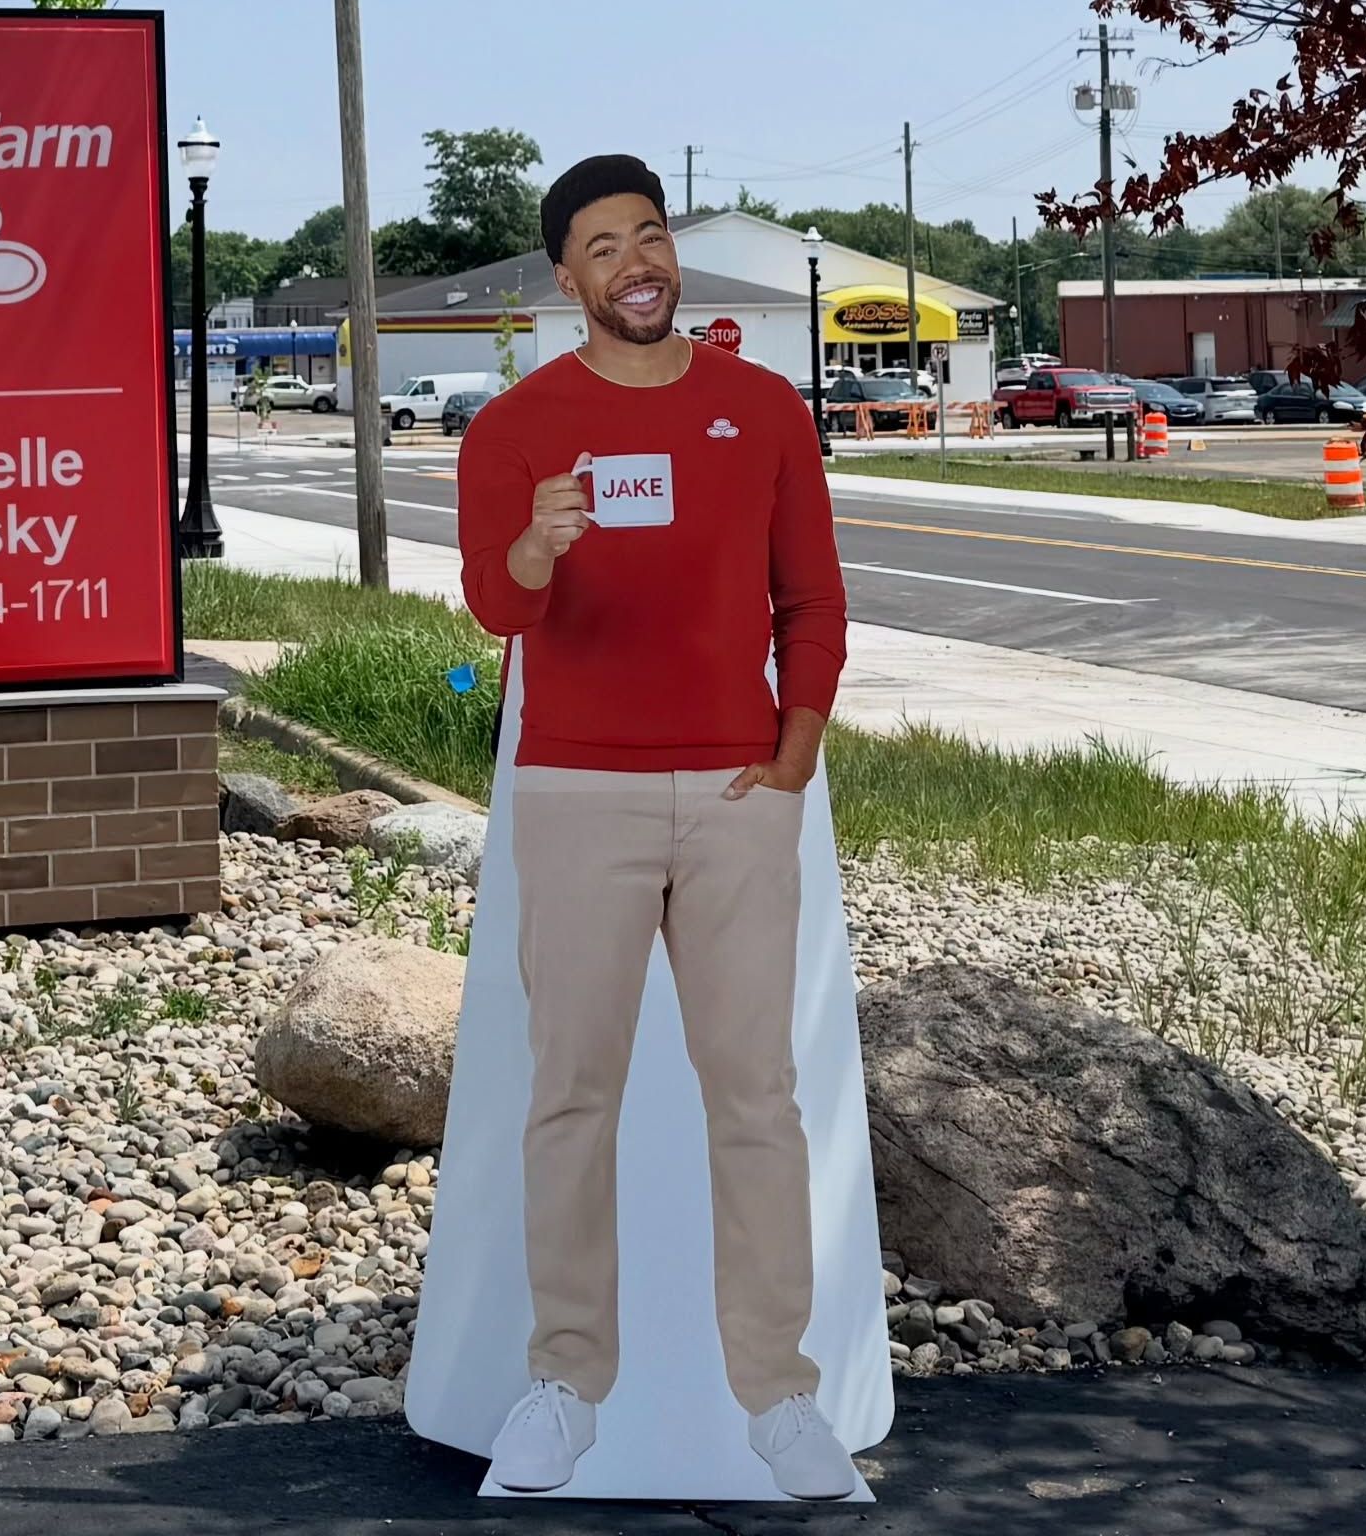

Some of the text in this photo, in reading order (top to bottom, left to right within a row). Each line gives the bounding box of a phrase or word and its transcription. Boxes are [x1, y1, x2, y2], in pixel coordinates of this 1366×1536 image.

[842, 304, 909, 321] ROSS
[709, 328, 740, 343] STOP
[602, 477, 664, 499] JAKE
